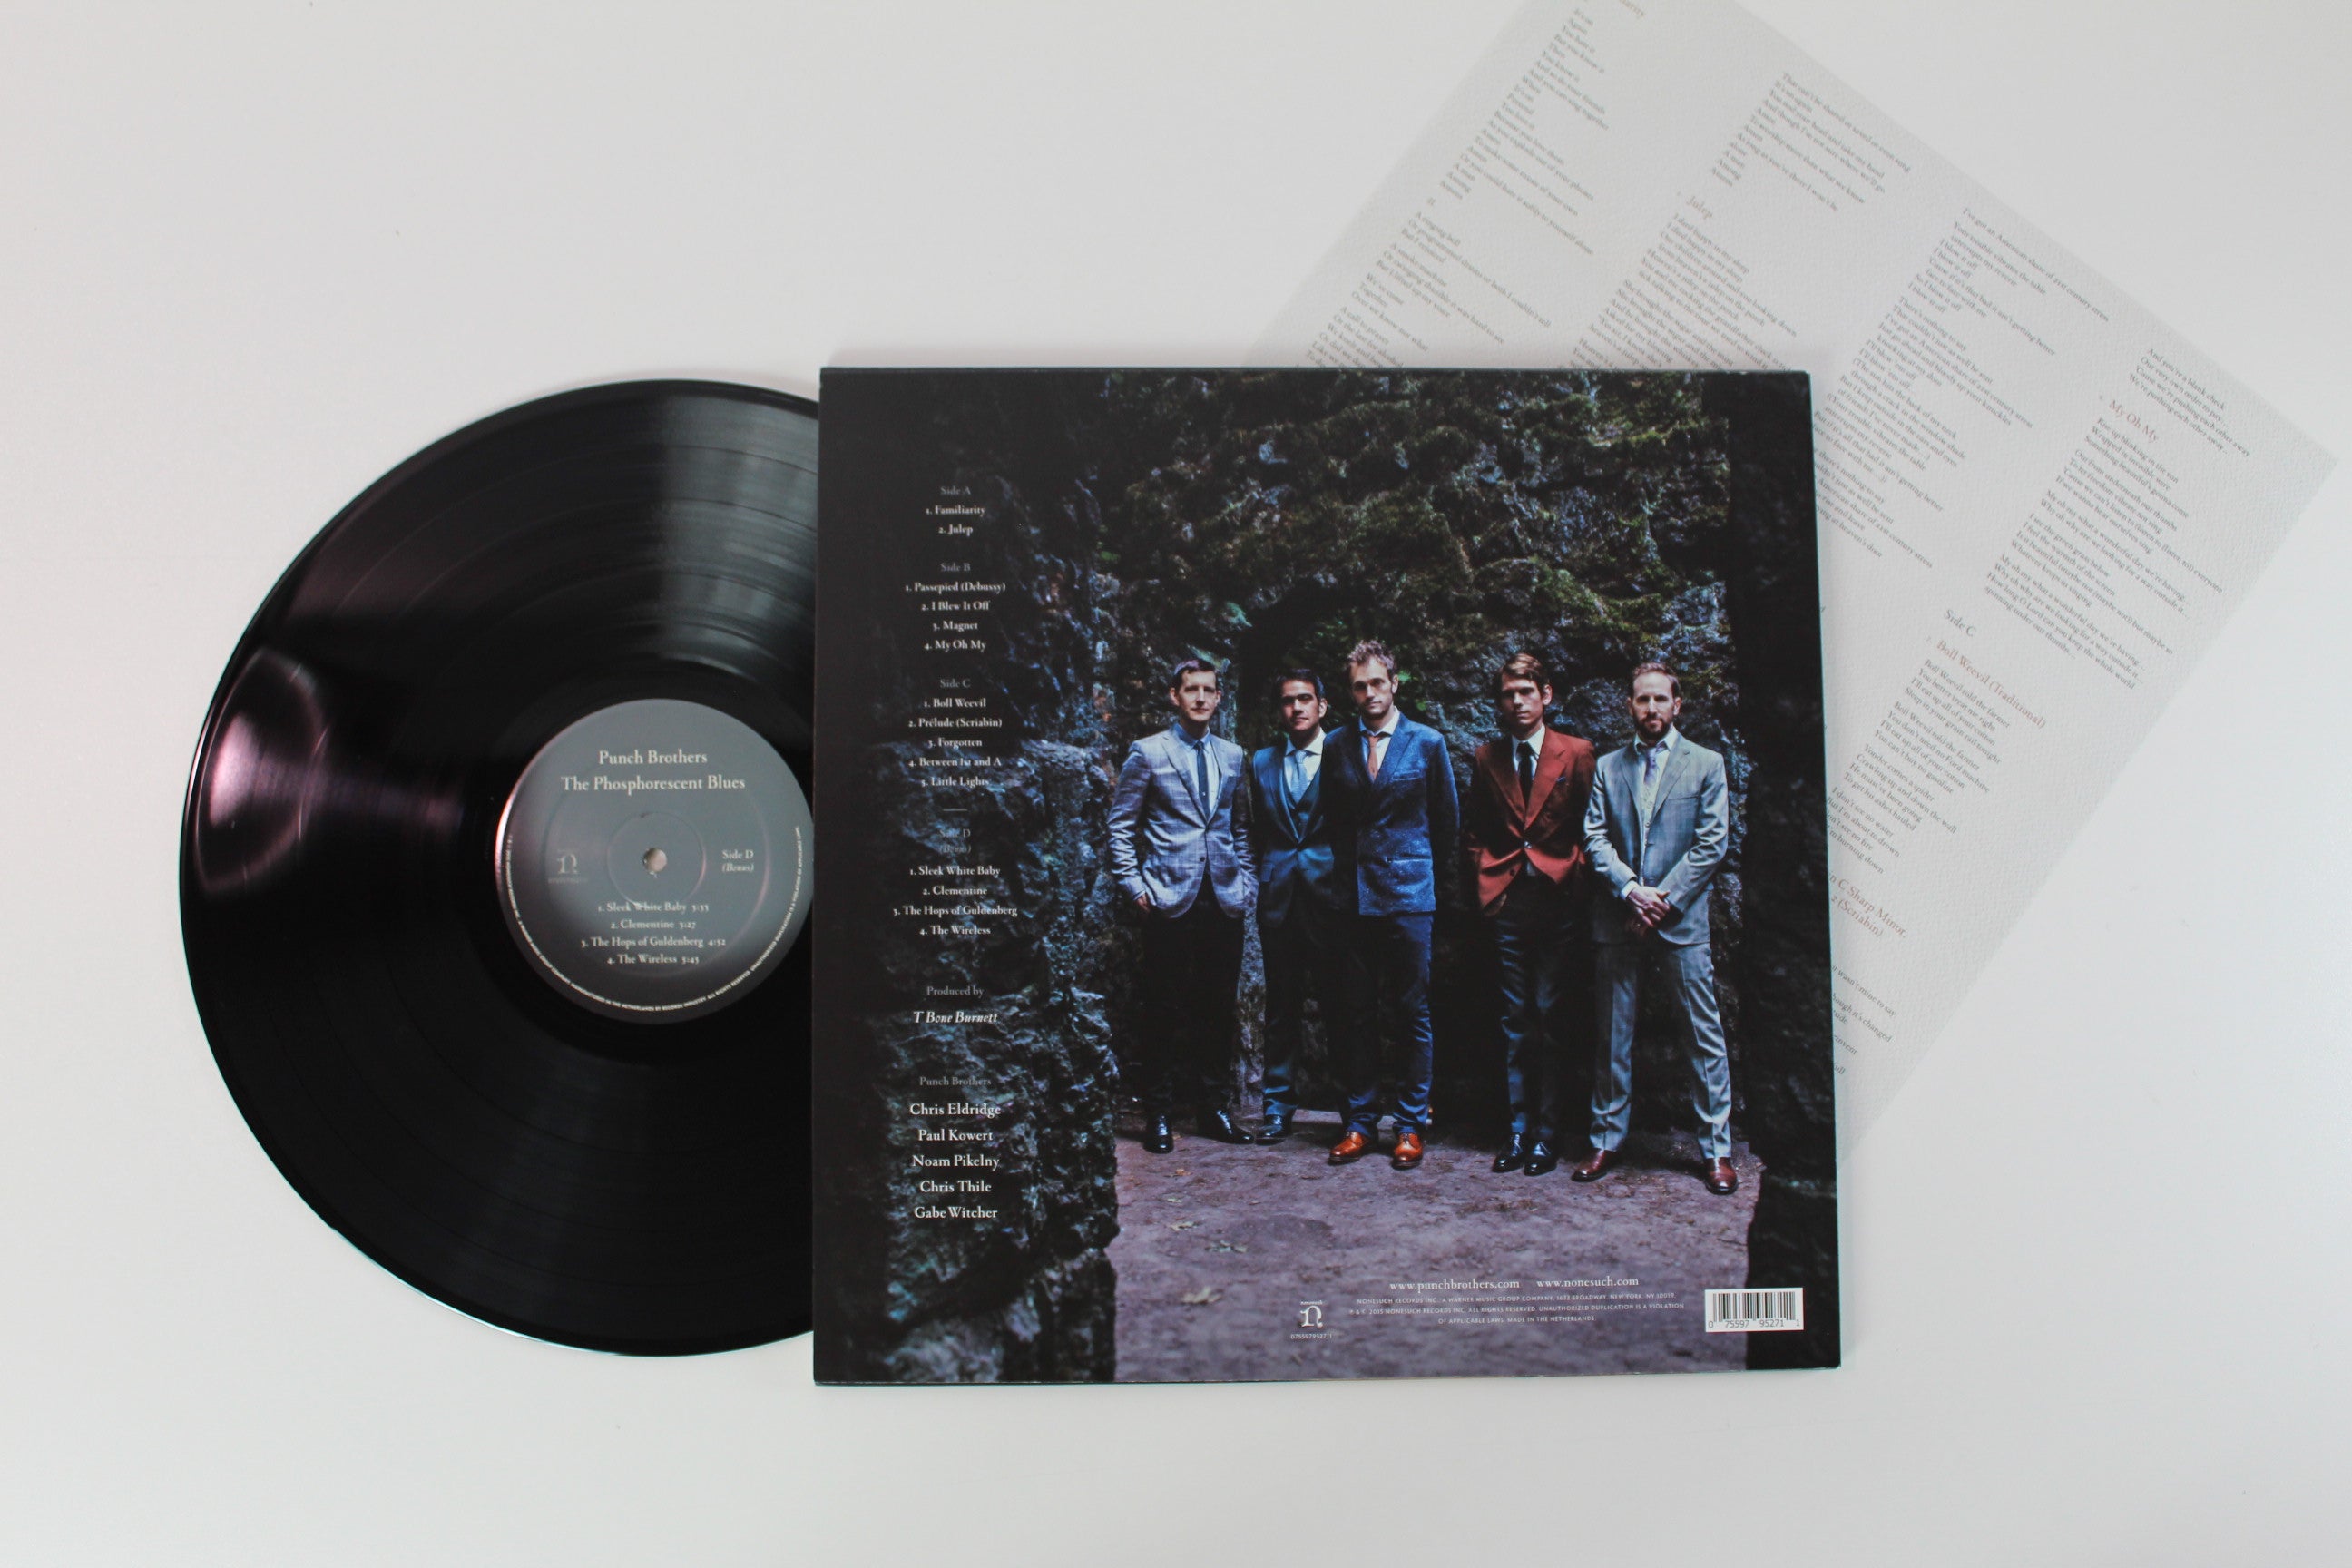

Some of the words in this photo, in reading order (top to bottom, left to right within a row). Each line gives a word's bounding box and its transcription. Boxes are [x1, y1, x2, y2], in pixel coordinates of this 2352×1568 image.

[2109, 399, 2123, 417] My
[2126, 413, 2140, 428] Oh
[2142, 424, 2156, 443] My
[940, 485, 961, 495] Side
[962, 486, 971, 495] A
[935, 504, 986, 517] Familiarity
[948, 524, 973, 536] Julep
[940, 562, 961, 571] Side
[963, 562, 970, 571] B
[914, 581, 959, 595] Passepied
[960, 581, 1006, 594] (Debussy)
[931, 601, 935, 611] I
[938, 601, 960, 610] Blew
[963, 601, 970, 610] It
[973, 600, 990, 610] Off
[943, 620, 978, 632] Magnet
[1944, 609, 1965, 629] Side
[1966, 626, 1976, 636] C
[935, 640, 950, 652] My
[952, 639, 968, 649] Oh
[970, 640, 985, 652] My
[940, 678, 960, 688] Side
[962, 679, 970, 688] C
[1937, 640, 1959, 660] Boll
[1960, 655, 1990, 684] Weevil
[1989, 682, 2046, 728] (Traditional)
[933, 698, 952, 708] Boll
[955, 697, 986, 707] Weevil
[956, 717, 1002, 727] (Scriabin)
[938, 737, 982, 750] Forgotten
[599, 749, 643, 764] Punch
[648, 748, 707, 764] Brothers
[919, 757, 958, 766] Between
[973, 756, 991, 766] and
[993, 757, 1002, 766] A
[560, 775, 589, 791] The
[594, 774, 702, 796] Phosphorescent
[707, 774, 745, 789] Blues
[930, 776, 957, 786] Little
[960, 776, 990, 789] Lights
[963, 829, 970, 838] D
[722, 849, 742, 859] Side
[745, 850, 754, 859] D
[918, 865, 944, 875] Sleek
[945, 865, 975, 875] White
[977, 865, 1000, 878] Baby
[932, 885, 987, 895] Clementine
[1839, 879, 1849, 890] C
[1848, 886, 1874, 913] Sharp
[606, 901, 631, 912] Sleek
[634, 901, 662, 912] White
[663, 901, 687, 915] Baby
[903, 906, 922, 915] The
[924, 906, 949, 918] Hops
[951, 906, 960, 915] of
[963, 906, 1018, 917] Guldenberg
[620, 918, 674, 929] Clementine
[1839, 900, 1883, 937] (Scriabin)
[930, 925, 949, 935] The
[951, 924, 991, 935] Wireless
[591, 936, 609, 946] The
[611, 936, 636, 950] Hops
[637, 936, 647, 946] of
[650, 936, 704, 949] Guldenberg
[617, 953, 636, 963] The
[637, 953, 677, 963] Wireless
[926, 985, 970, 995] Produced
[973, 985, 985, 998] by
[913, 1011, 924, 1023] T
[926, 1011, 953, 1023] Bone
[955, 1010, 999, 1023] Burnett
[920, 1076, 949, 1085] Punch
[952, 1076, 991, 1087] Brothers
[909, 1103, 944, 1115] Chris
[948, 1103, 1001, 1118] Eldridge
[918, 1128, 945, 1141] Paul
[948, 1128, 994, 1141] Kowert
[911, 1154, 950, 1167] Noam
[954, 1154, 1000, 1171] Pikelny
[920, 1180, 954, 1193] Chris
[957, 1180, 991, 1192] Thile
[913, 1205, 946, 1218] Gabe
[947, 1205, 998, 1218] Witcher
[1389, 1278, 1519, 1294] www.punchbrothers.com
[1536, 1275, 1639, 1288] www.nonesuch.com
[1725, 1320, 1750, 1328] 75597
[1759, 1319, 1784, 1327] 95271
